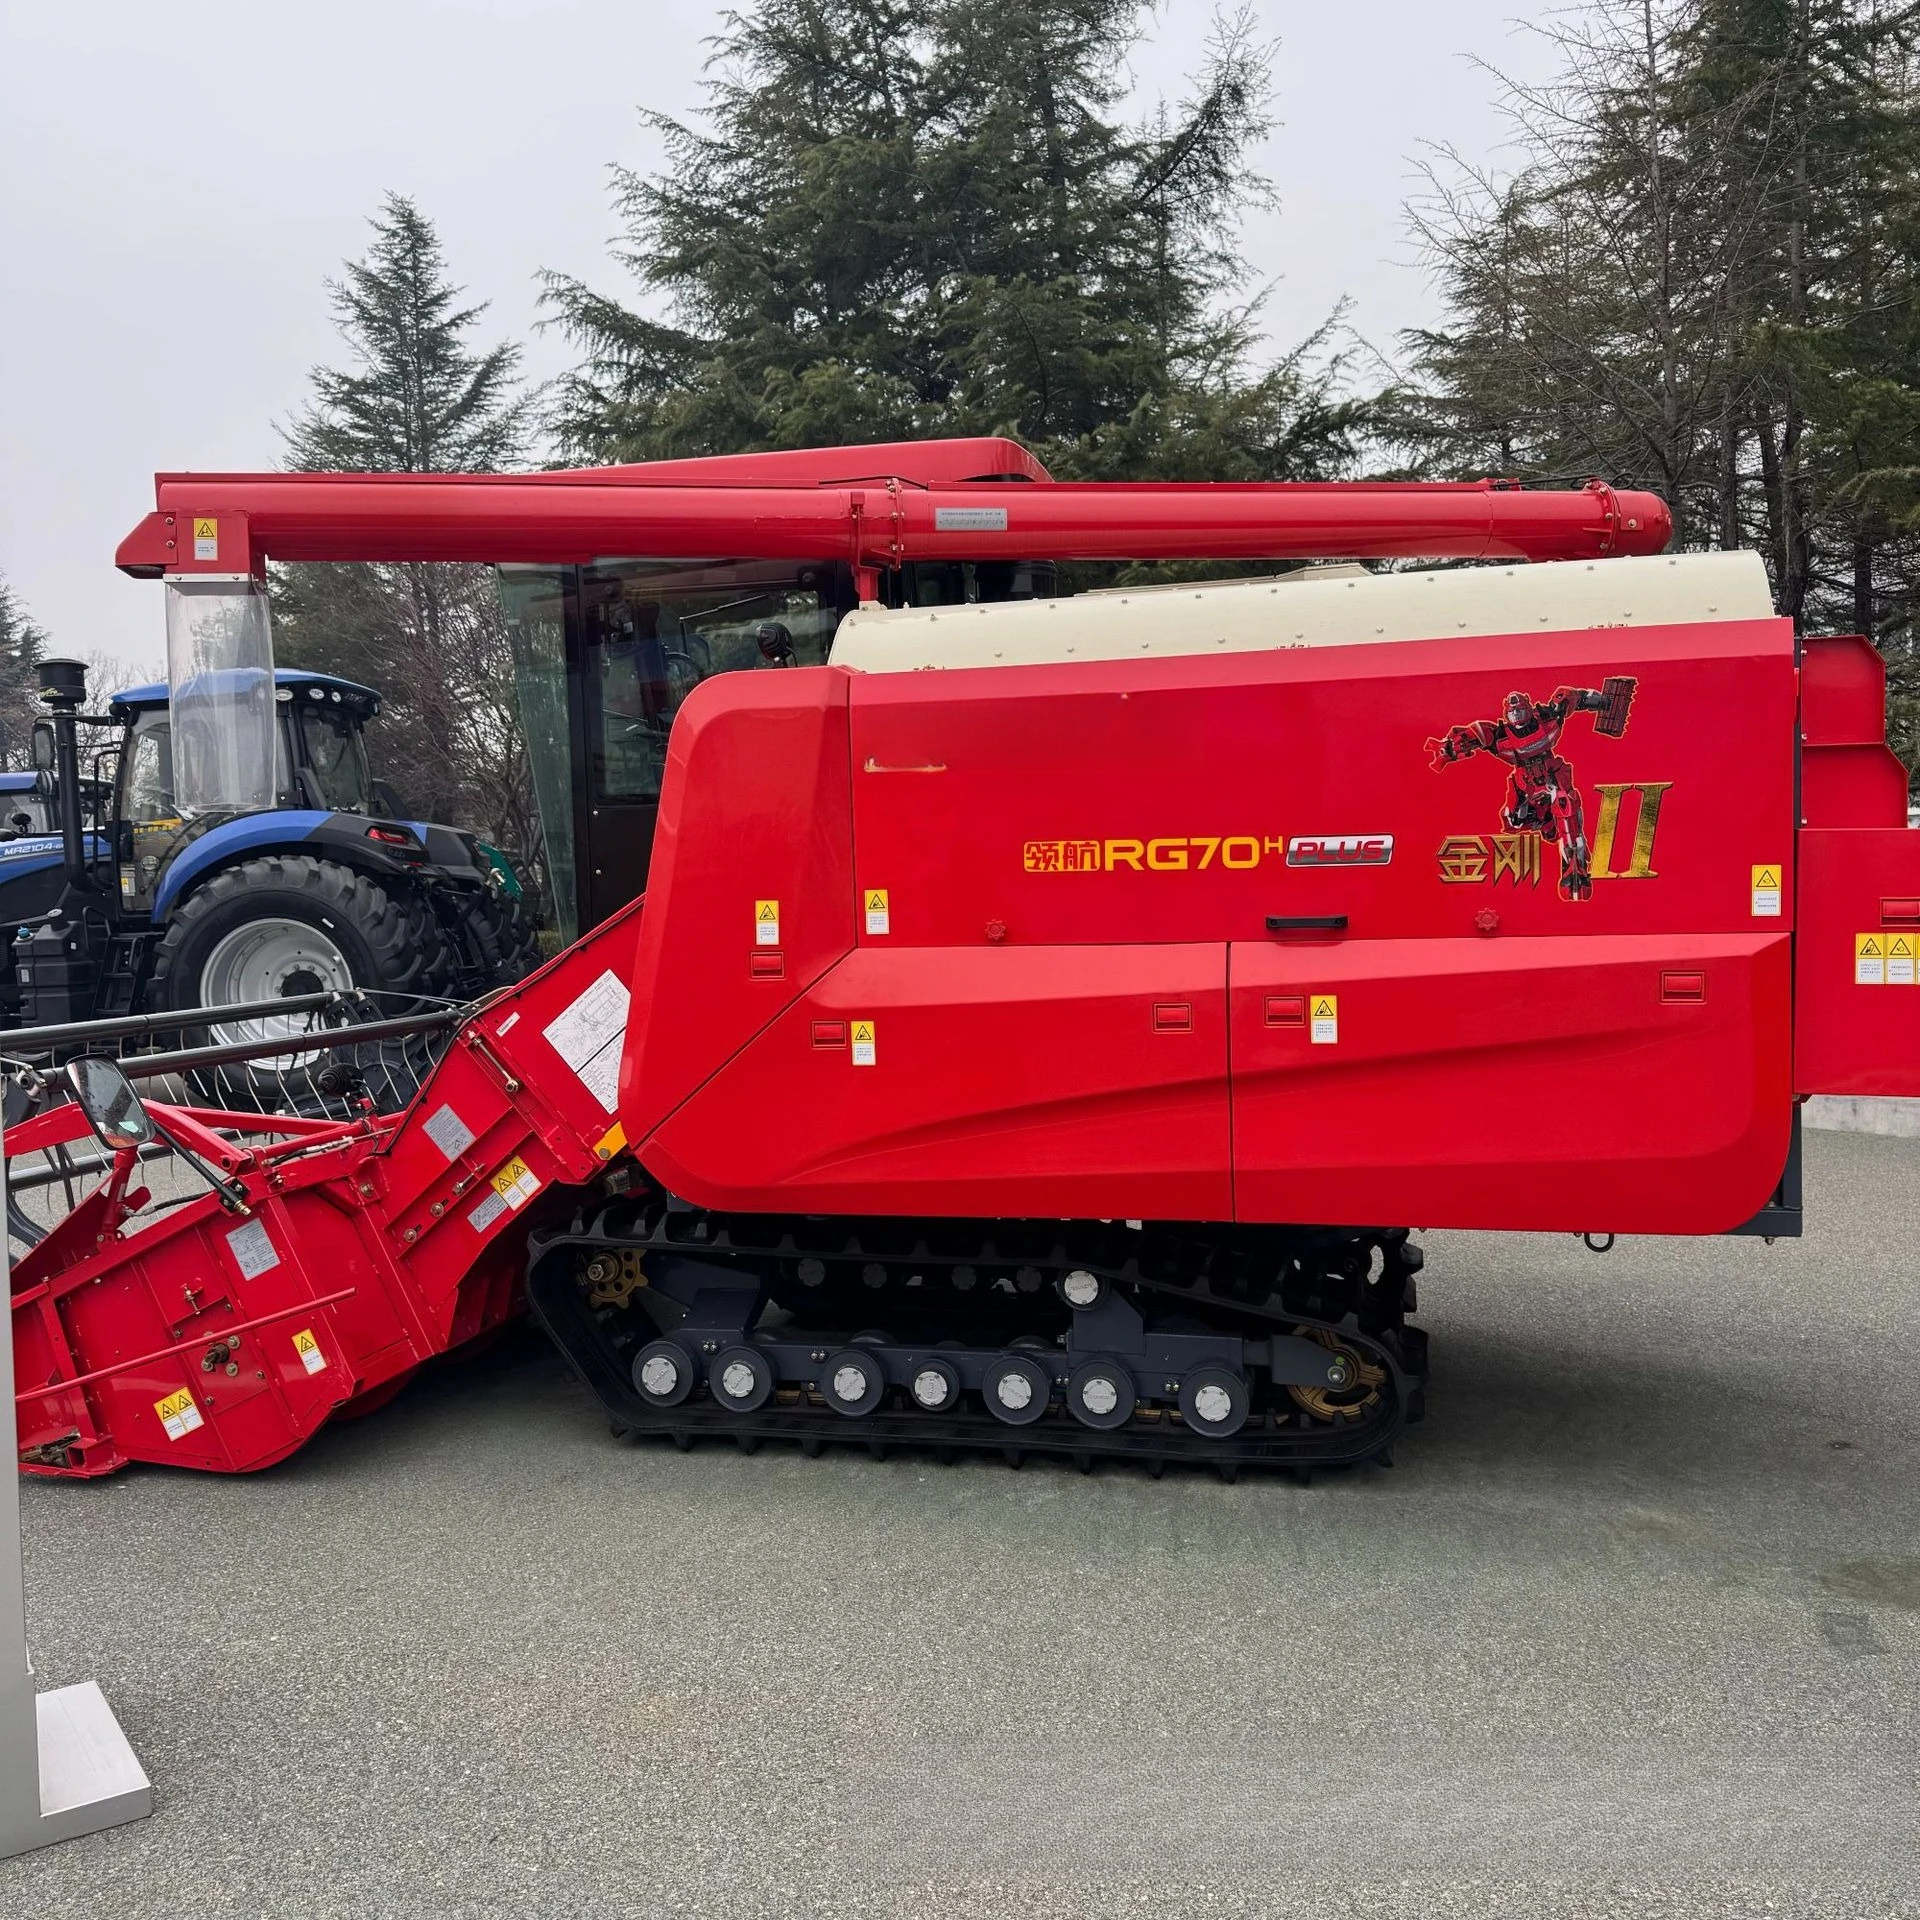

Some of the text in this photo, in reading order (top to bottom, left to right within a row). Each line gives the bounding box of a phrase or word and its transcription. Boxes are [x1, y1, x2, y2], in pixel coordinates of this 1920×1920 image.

[1025, 841, 1098, 871] 领航
[1294, 840, 1385, 863] PLUS
[1436, 834, 1542, 888] 金刚
